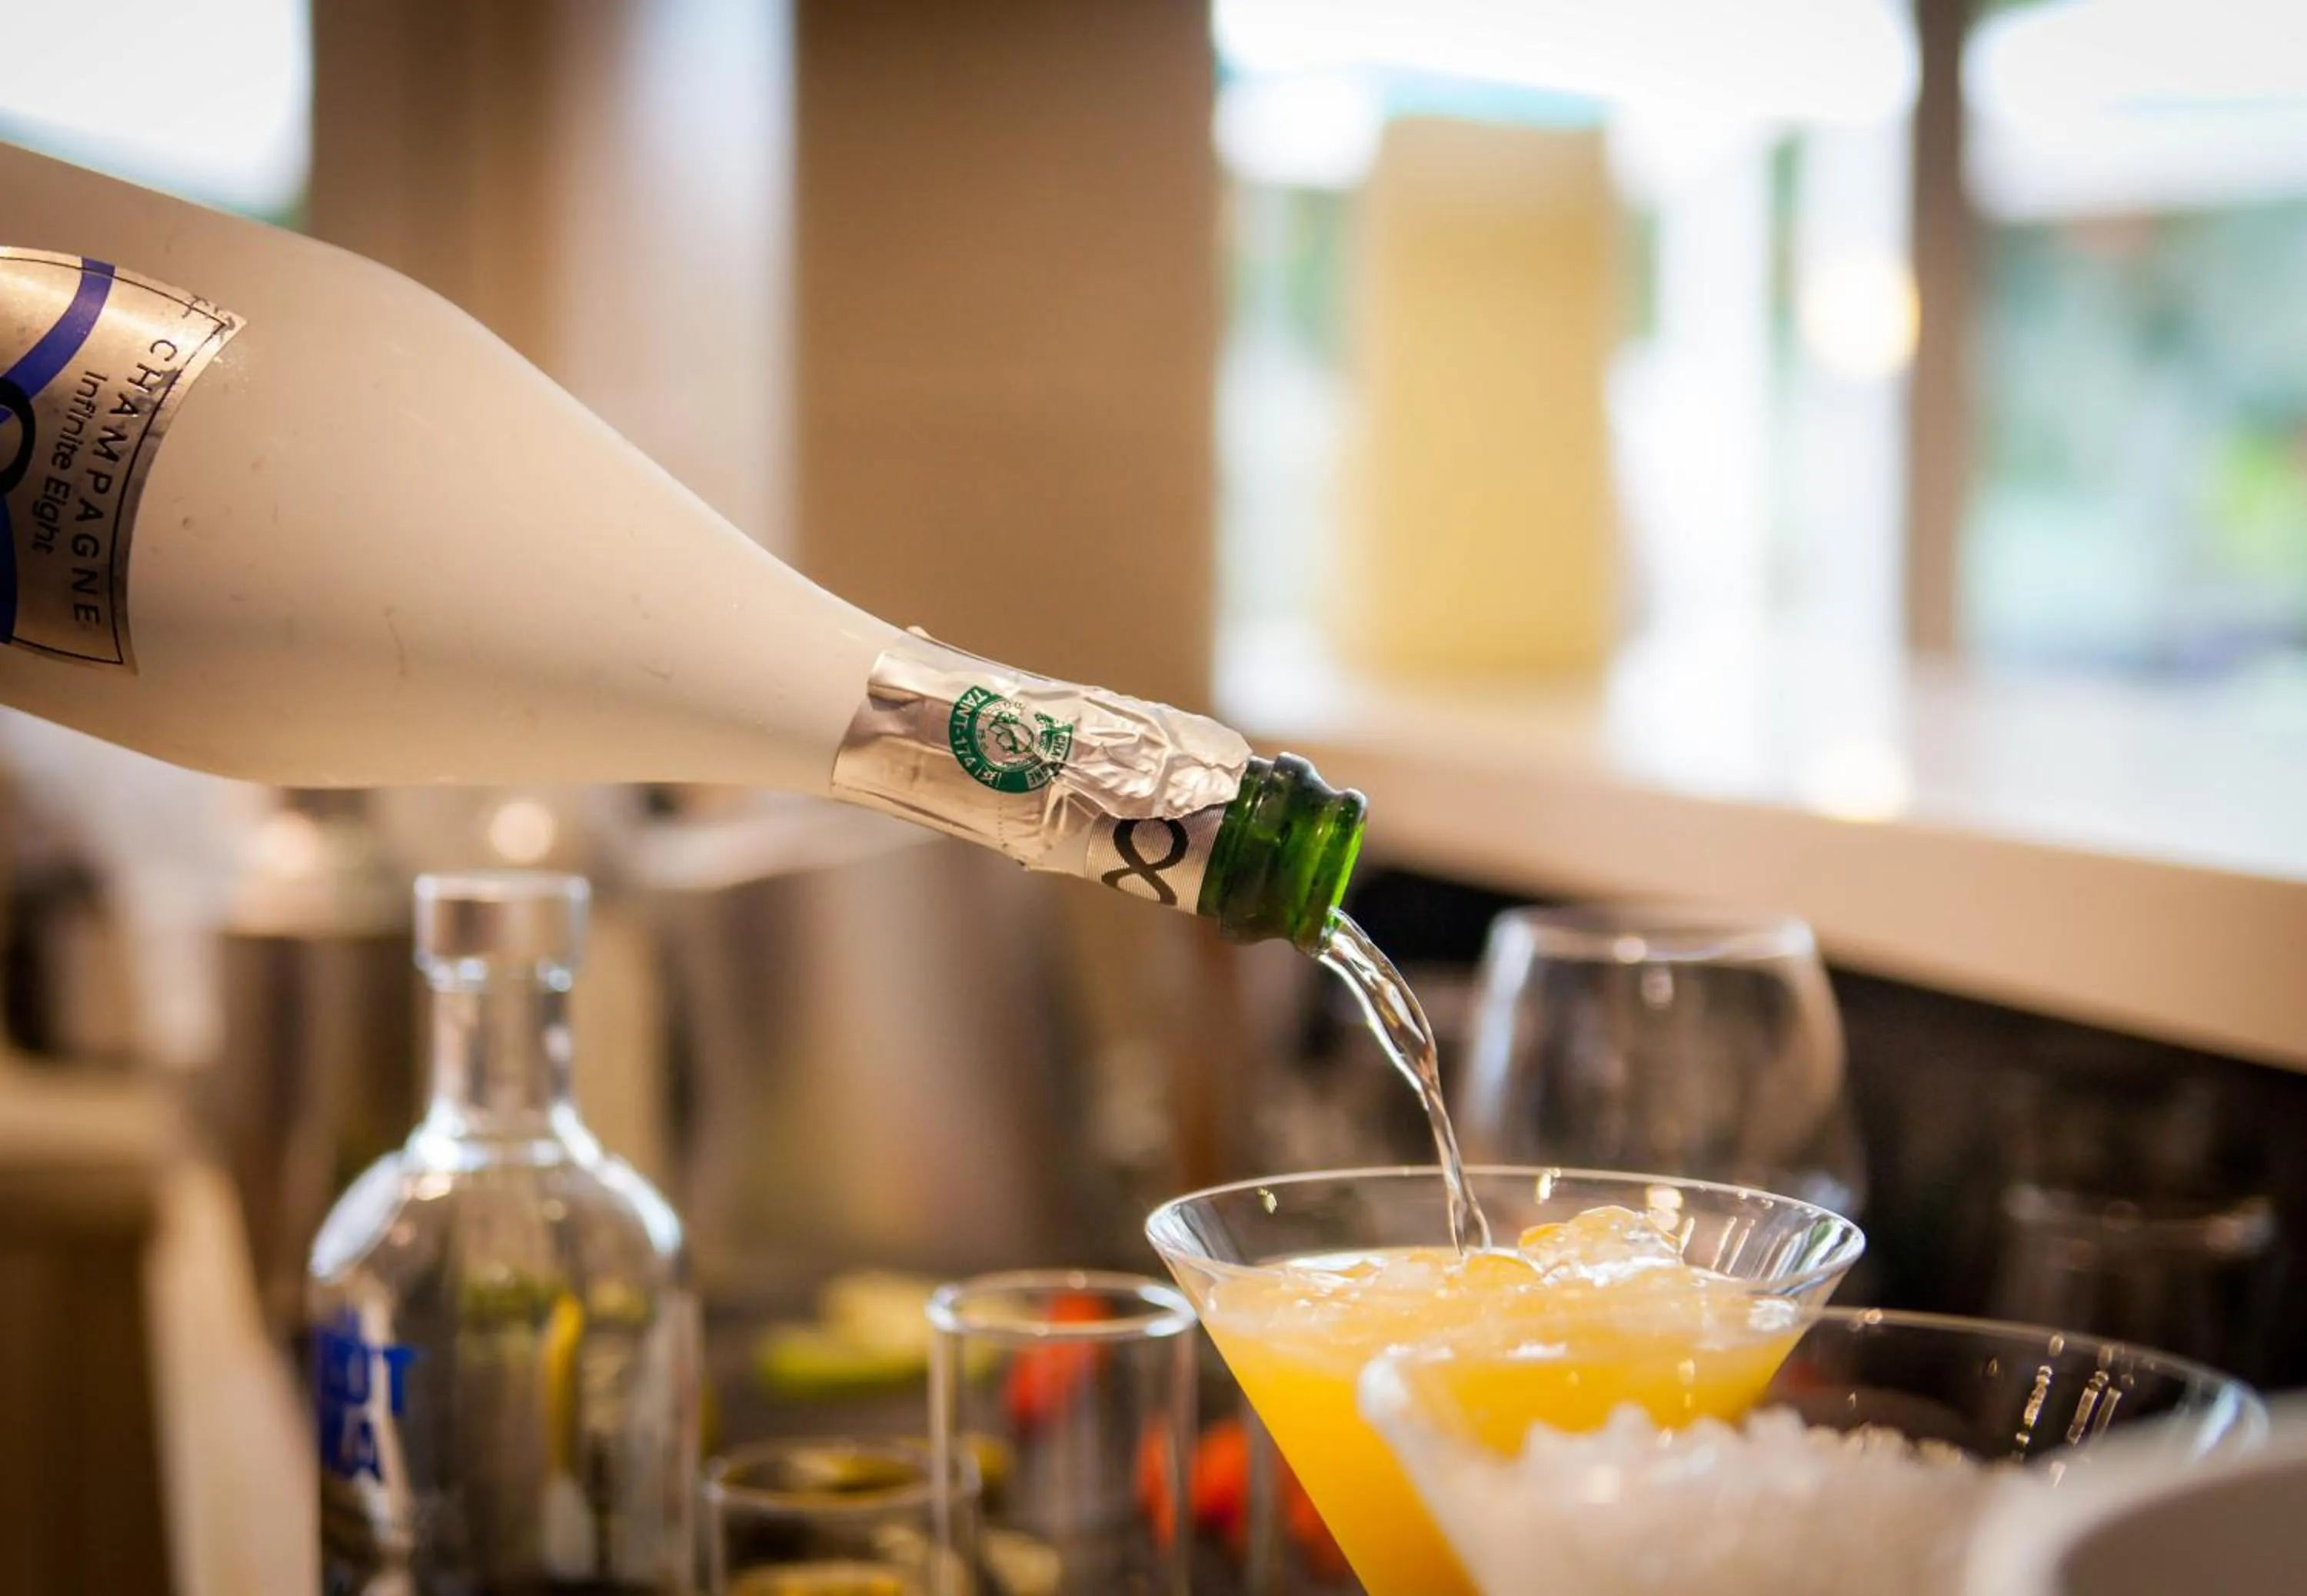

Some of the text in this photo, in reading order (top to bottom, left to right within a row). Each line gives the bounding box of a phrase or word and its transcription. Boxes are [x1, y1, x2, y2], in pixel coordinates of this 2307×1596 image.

[31, 370, 108, 555] Infinite Eight
[72, 337, 178, 625] CHAMPAGNE
